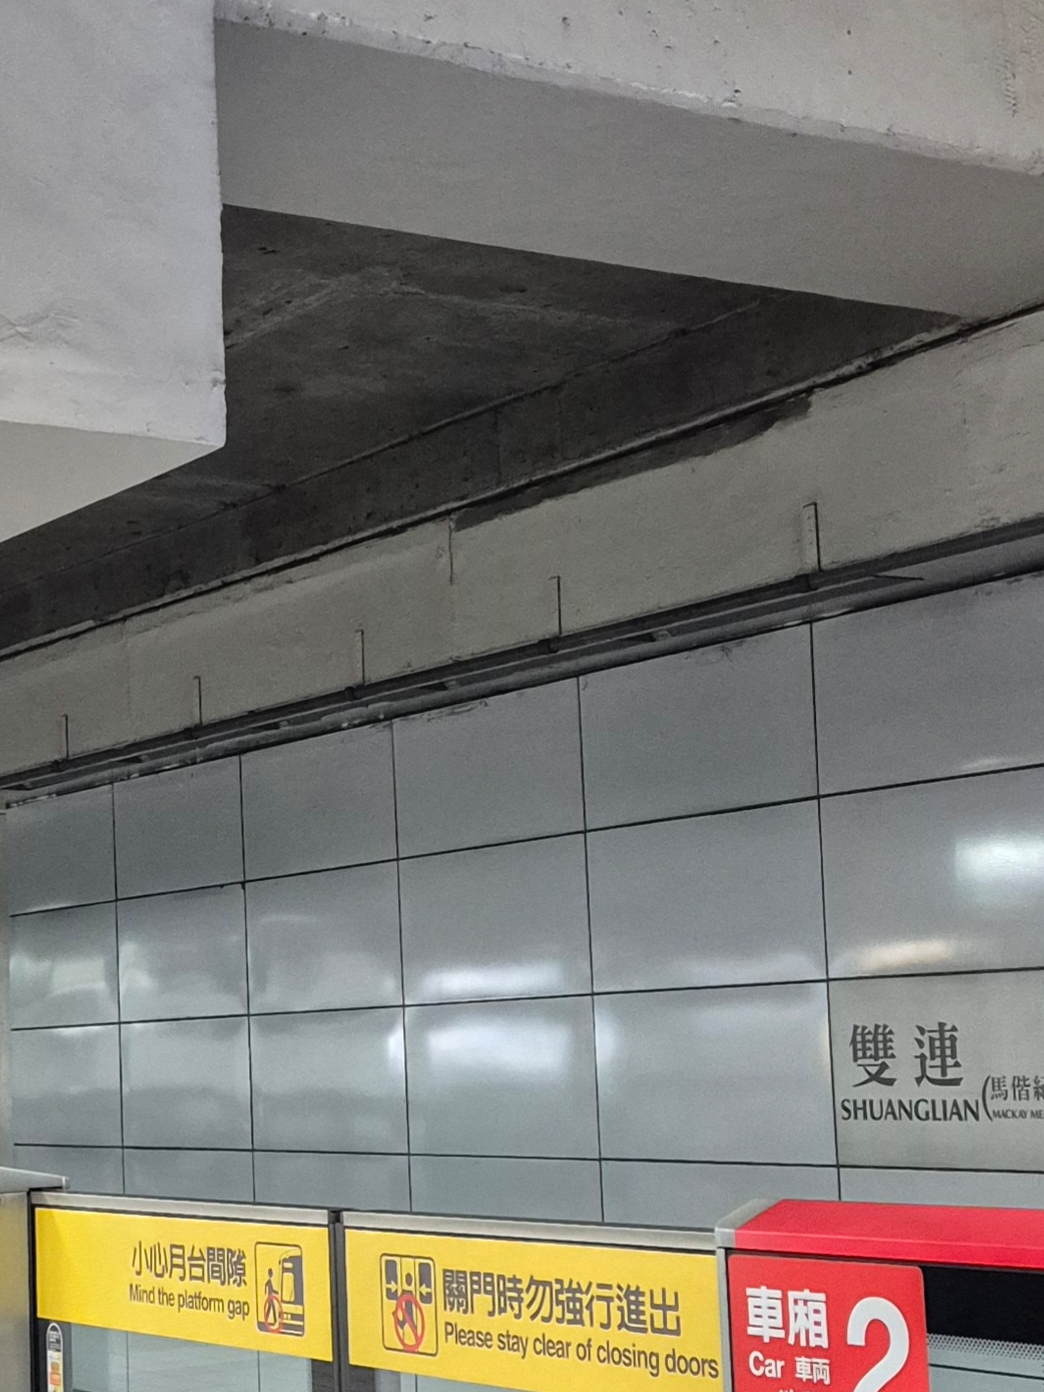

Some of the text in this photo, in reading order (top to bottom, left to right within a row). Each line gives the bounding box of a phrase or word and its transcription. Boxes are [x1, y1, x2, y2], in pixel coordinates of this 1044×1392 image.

[849, 1021, 964, 1088] 雙連
[841, 1098, 980, 1122] SHUANGLIAN
[992, 1109, 1027, 1119] MACKAY
[131, 1240, 248, 1289] 小心月台間隙
[129, 1283, 250, 1321] Mind the platform gap
[442, 1268, 682, 1337] 關門時勿強行進出
[745, 1285, 829, 1349] 車廂
[444, 1321, 719, 1379] Please stay clear of closing doors
[748, 1350, 785, 1379] Car
[794, 1355, 831, 1385] 車両
